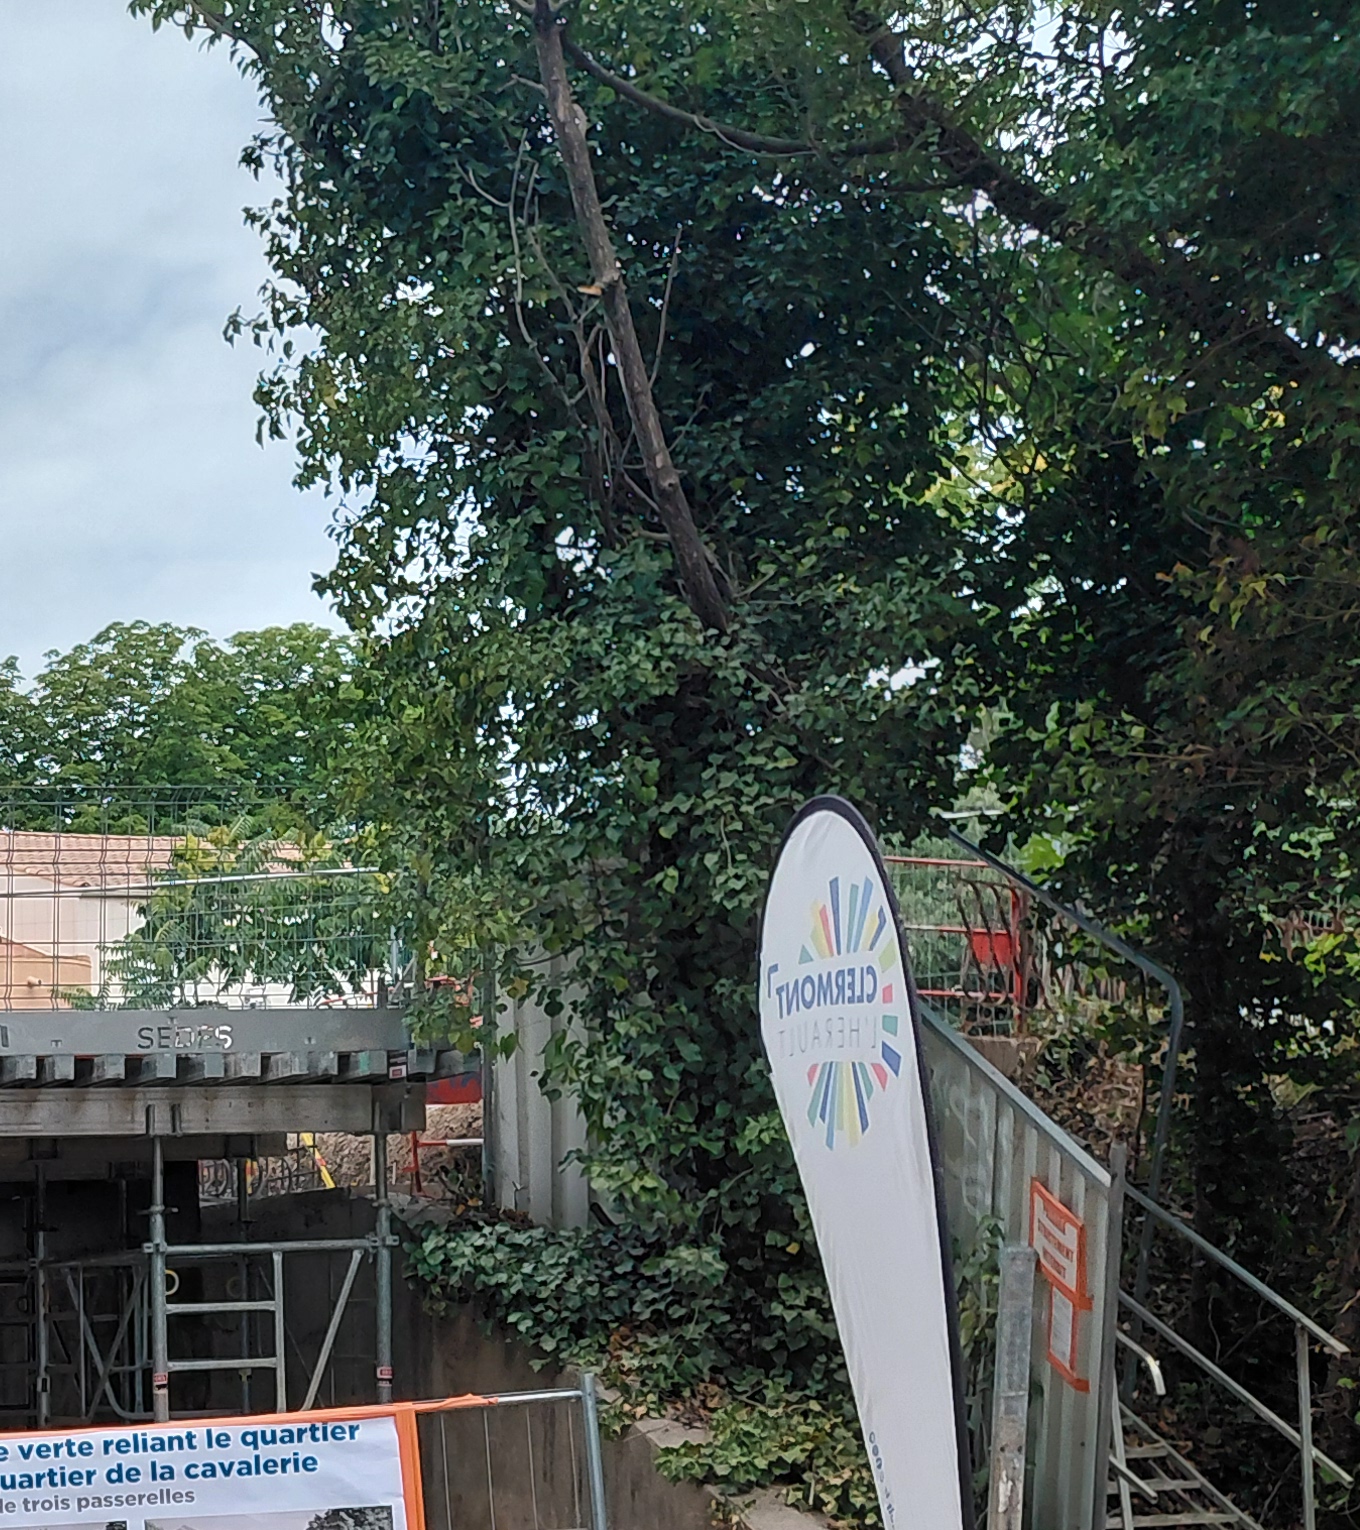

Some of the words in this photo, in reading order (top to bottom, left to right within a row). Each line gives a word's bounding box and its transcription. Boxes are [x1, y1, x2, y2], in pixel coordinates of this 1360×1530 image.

[137, 1025, 233, 1050] SEDES
[16, 1437, 95, 1461] verte
[102, 1428, 197, 1456] reliant
[206, 1427, 232, 1449] le
[240, 1422, 360, 1451] quartier
[105, 1462, 142, 1485] de
[150, 1460, 176, 1481] la
[184, 1451, 319, 1480] cavalerie
[23, 1490, 71, 1513] trois
[76, 1488, 195, 1512] passerelles
